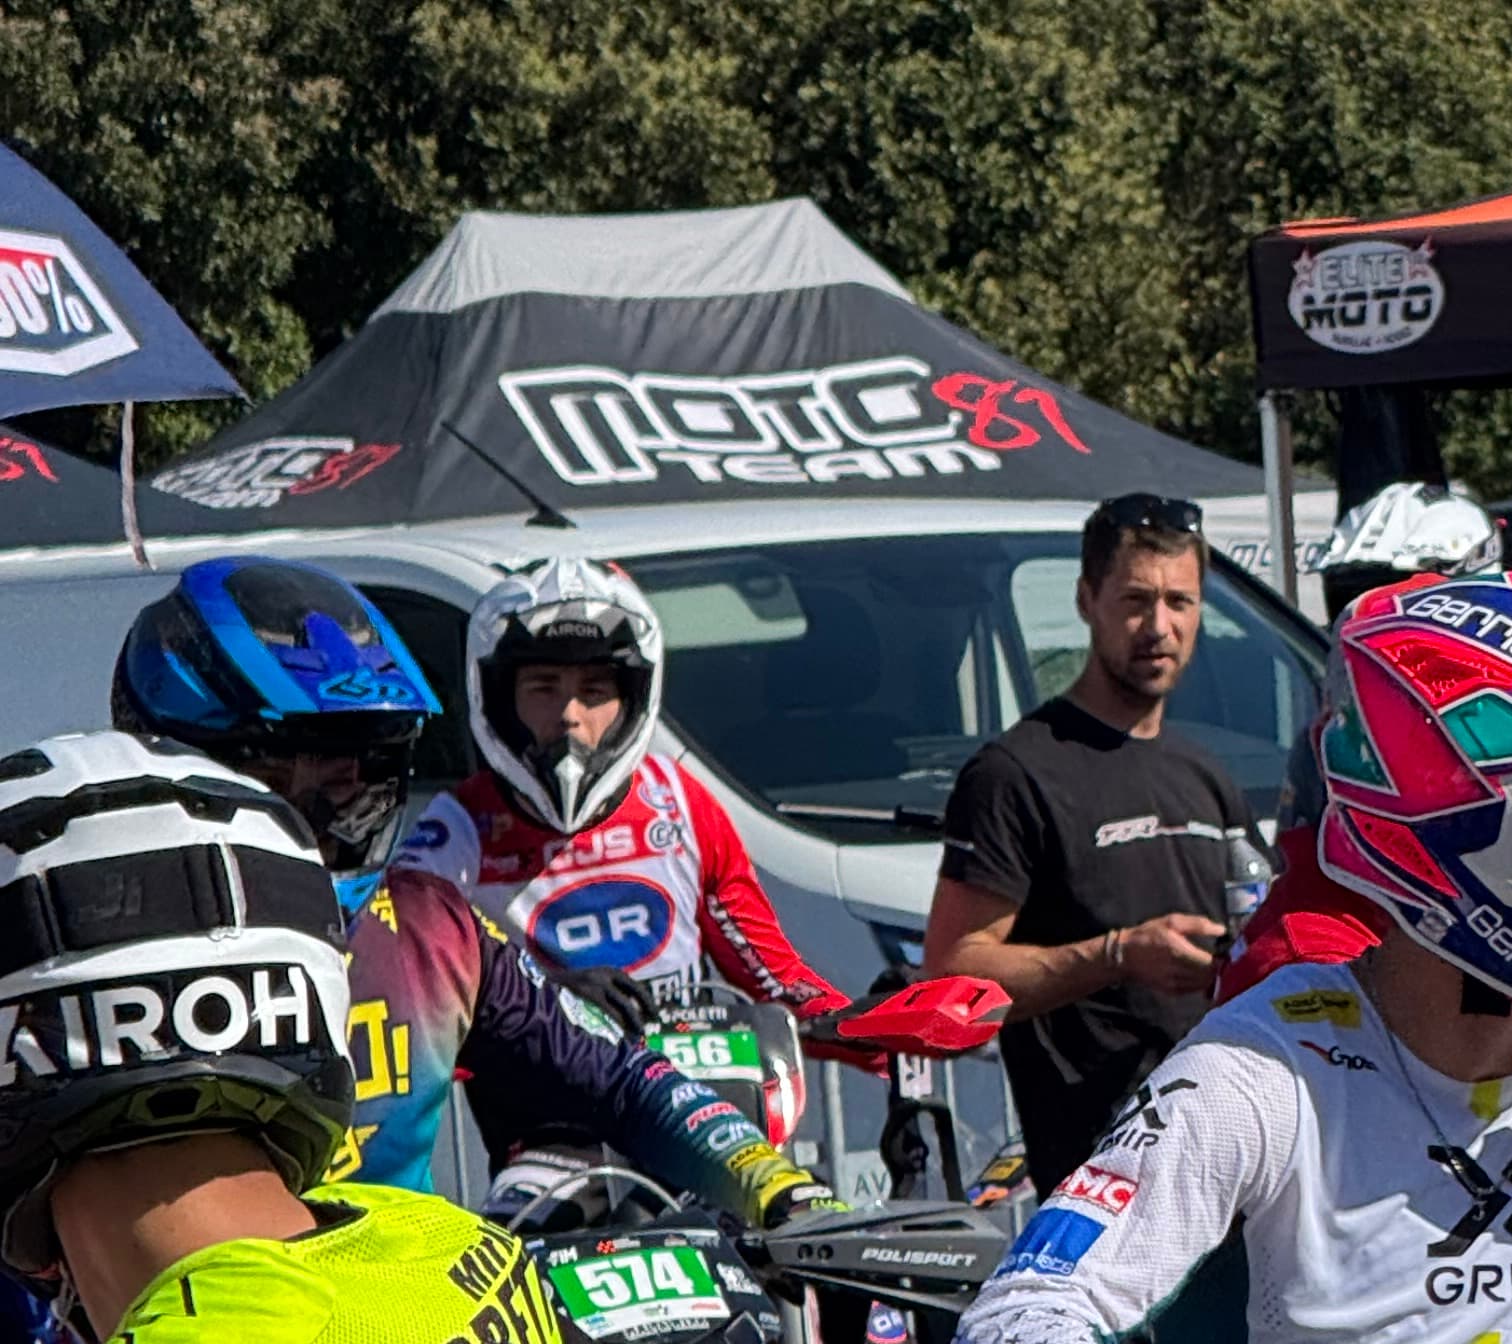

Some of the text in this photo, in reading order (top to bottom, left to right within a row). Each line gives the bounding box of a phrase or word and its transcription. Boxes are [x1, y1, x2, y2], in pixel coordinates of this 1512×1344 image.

[1320, 255, 1408, 290] ELITE
[1302, 284, 1433, 330] MOTO
[665, 446, 1002, 486] TEAM
[662, 1033, 735, 1067] 56
[861, 1247, 979, 1268] POLISPORT
[576, 1252, 714, 1310] 574
